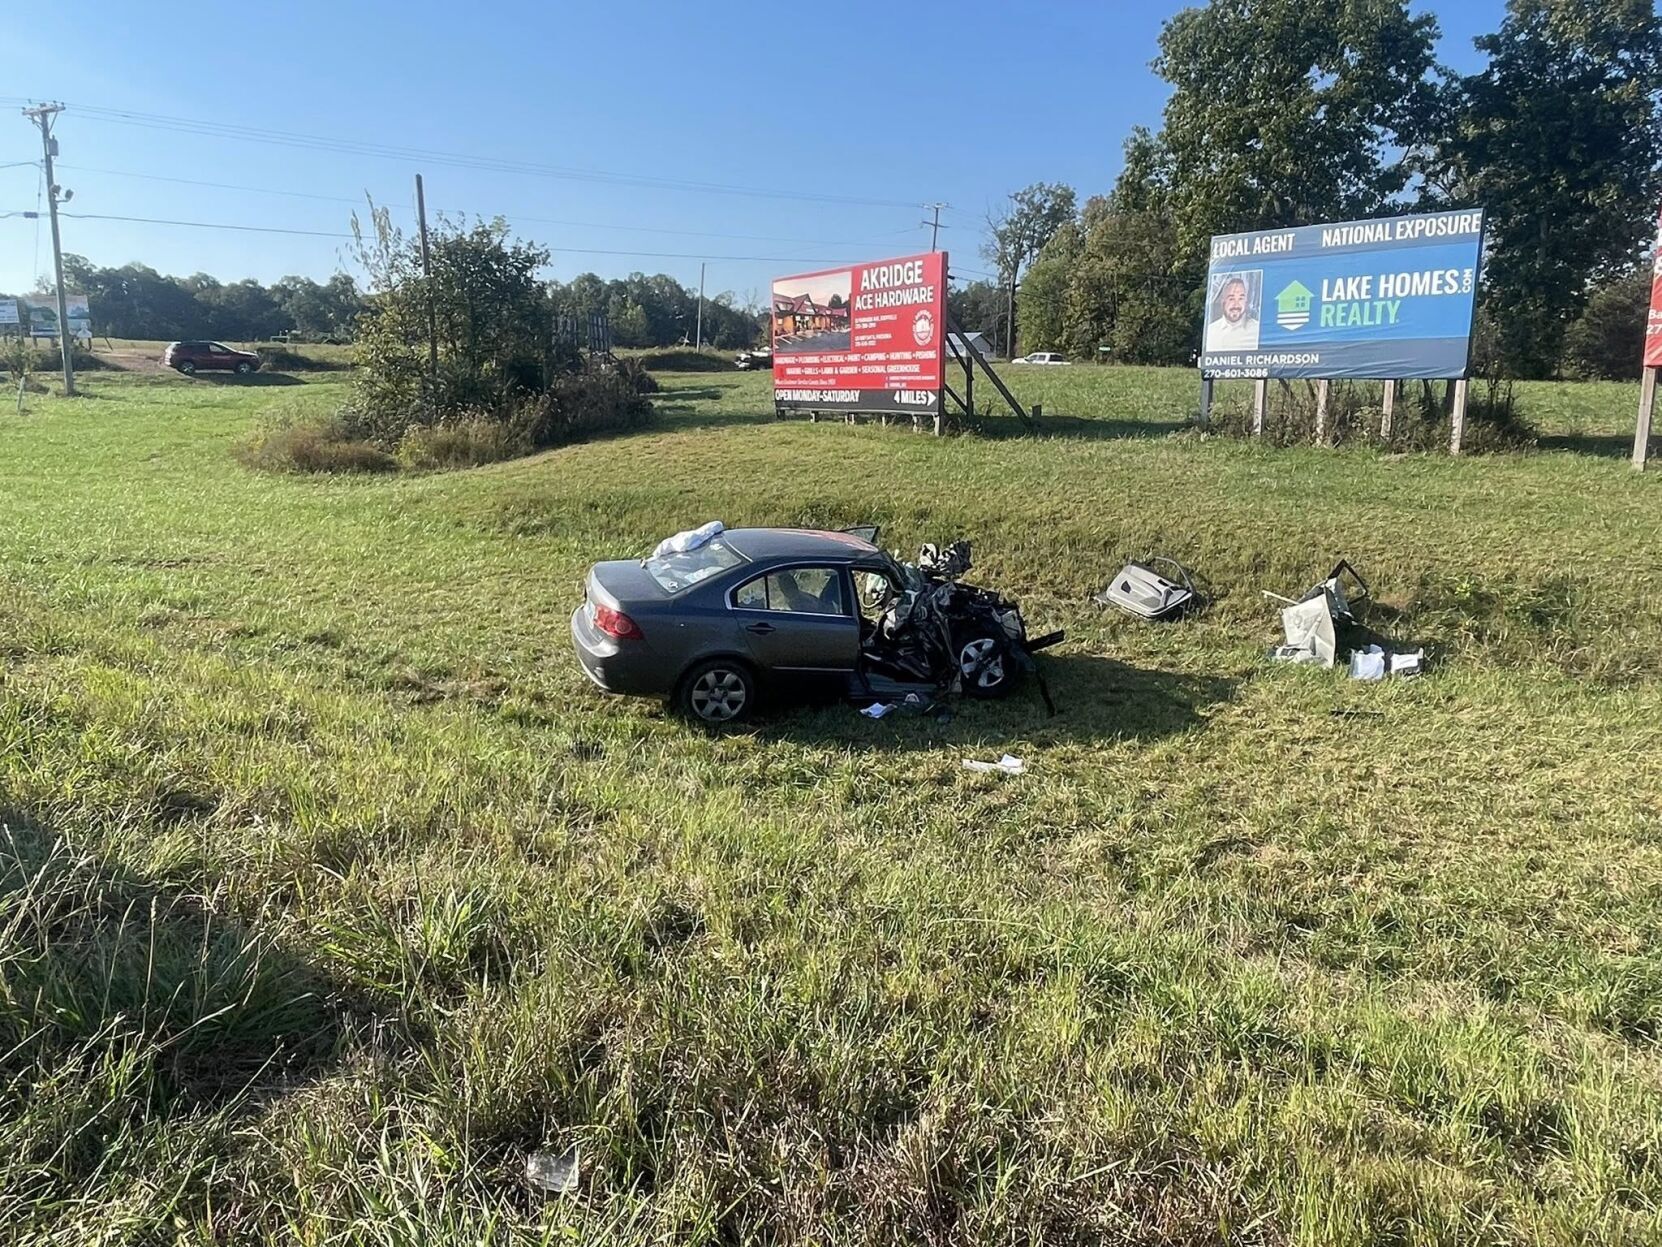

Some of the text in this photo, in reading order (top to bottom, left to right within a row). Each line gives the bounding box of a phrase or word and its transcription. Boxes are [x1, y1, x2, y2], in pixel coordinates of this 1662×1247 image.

[1212, 212, 1482, 259] LOCAL AGENT NATIONAL EXPOSURE
[860, 260, 924, 291] AKRIDGE
[854, 286, 934, 311] ACE HARDWARE
[1321, 276, 1369, 302] LAKE
[1319, 300, 1400, 328] REALTY
[1204, 353, 1319, 367] DANIEL RICHARDSON
[1204, 368, 1268, 378] 270-601-3086
[775, 390, 792, 401] OPEN
[893, 390, 900, 403] 4
[901, 390, 927, 404] MILES
